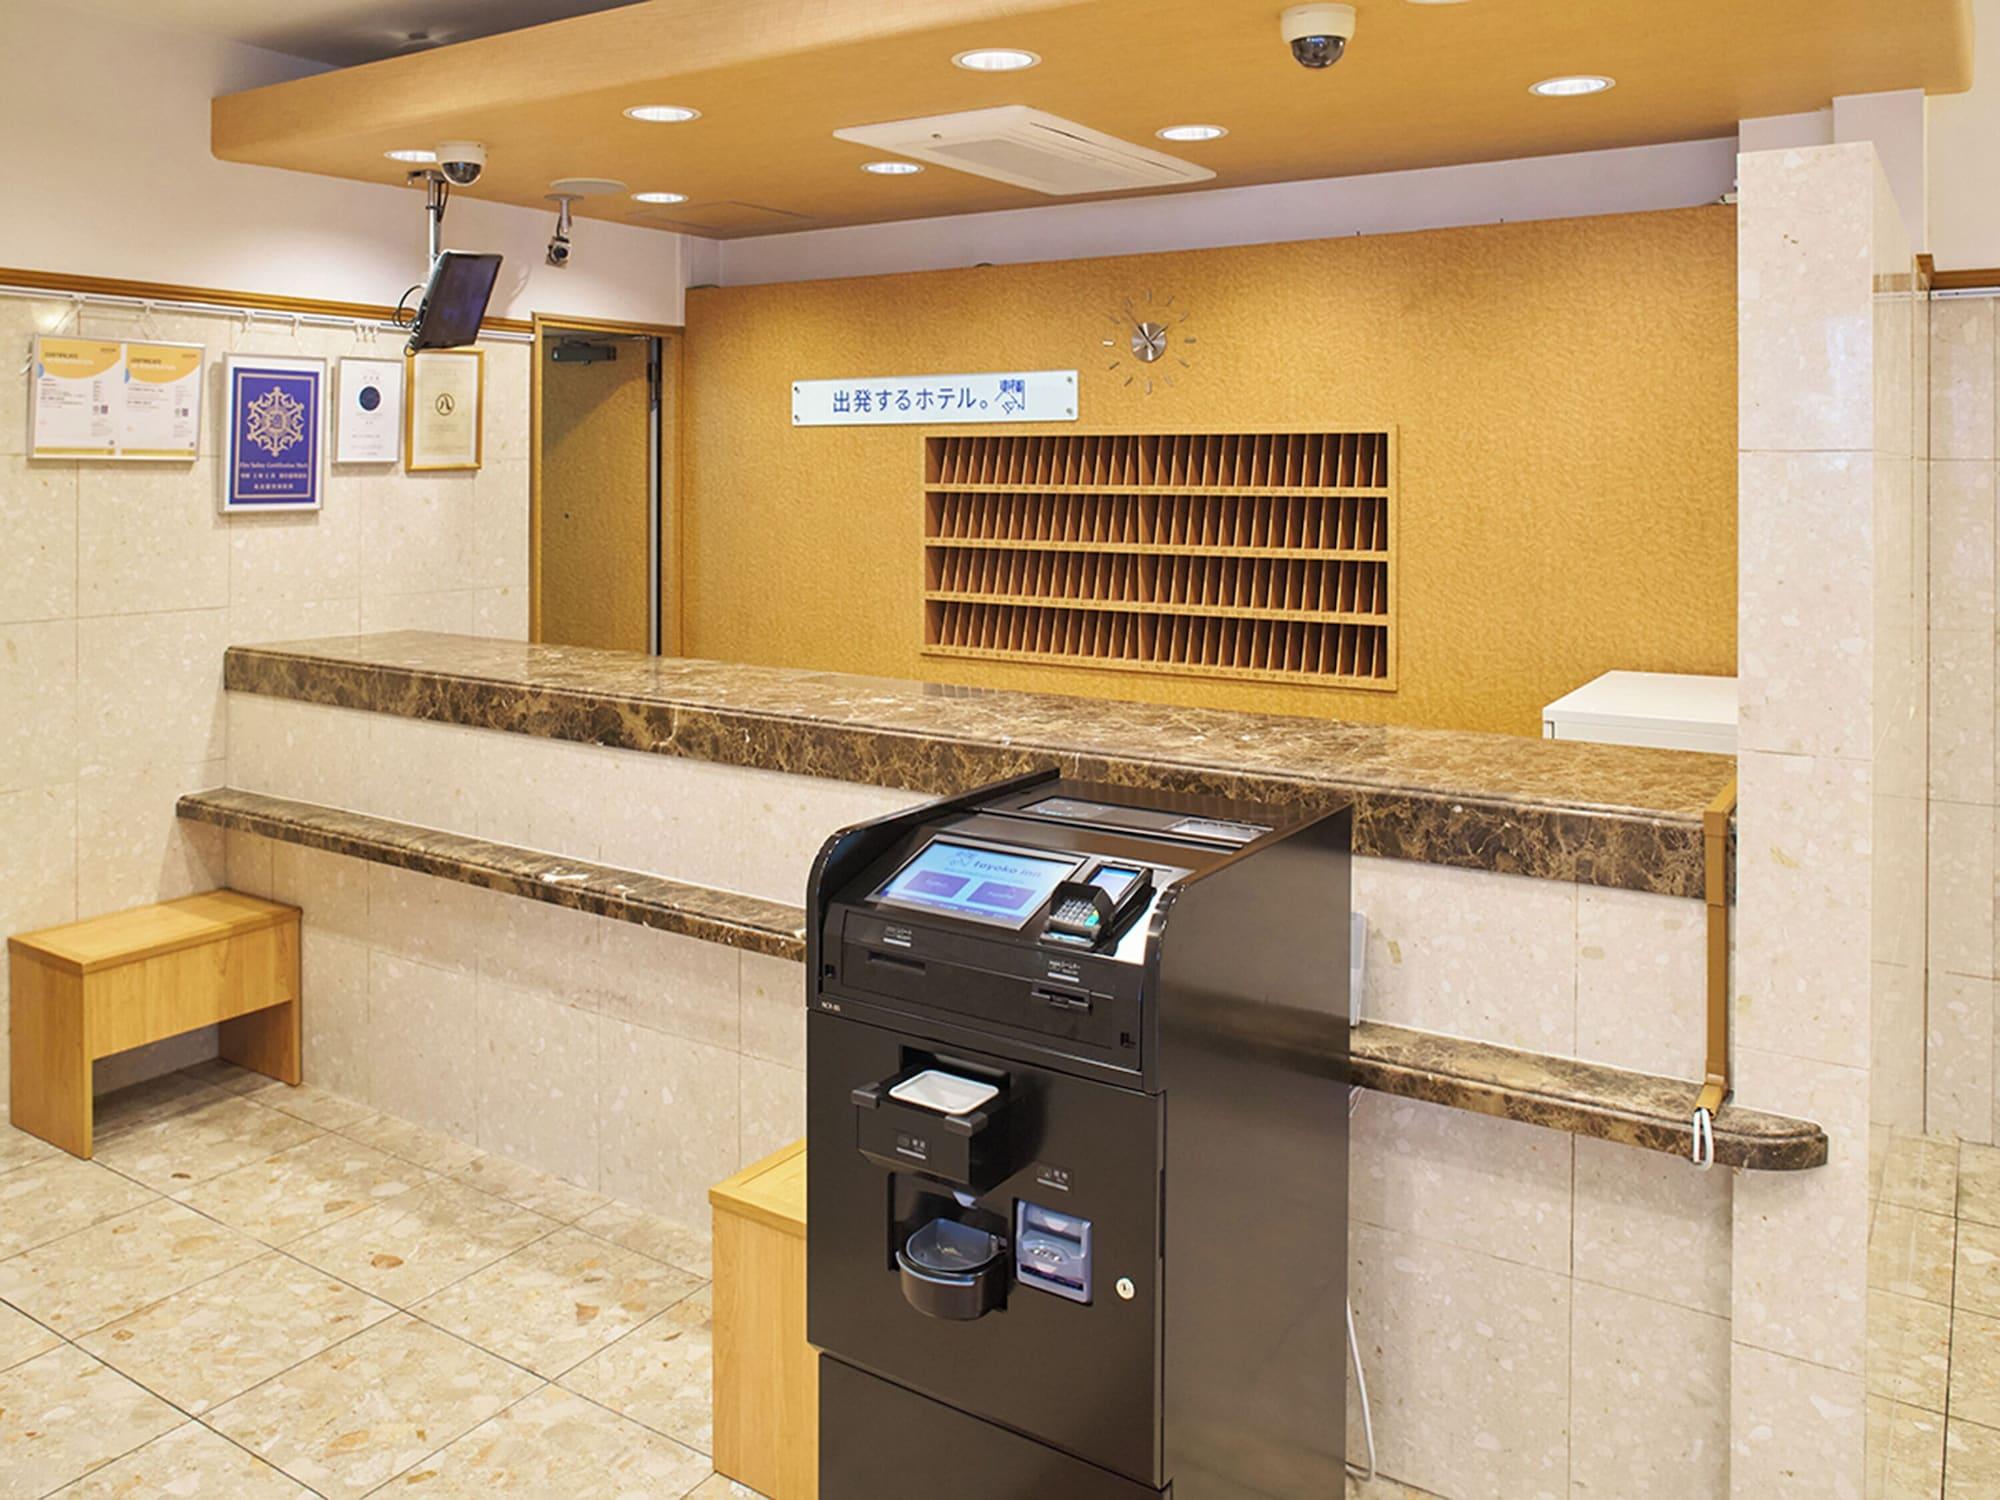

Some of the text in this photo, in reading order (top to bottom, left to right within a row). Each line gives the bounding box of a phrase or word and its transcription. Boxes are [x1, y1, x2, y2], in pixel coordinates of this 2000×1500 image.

[832, 387, 988, 414] 出発するホテル。
[973, 860, 1018, 875] toyoko
